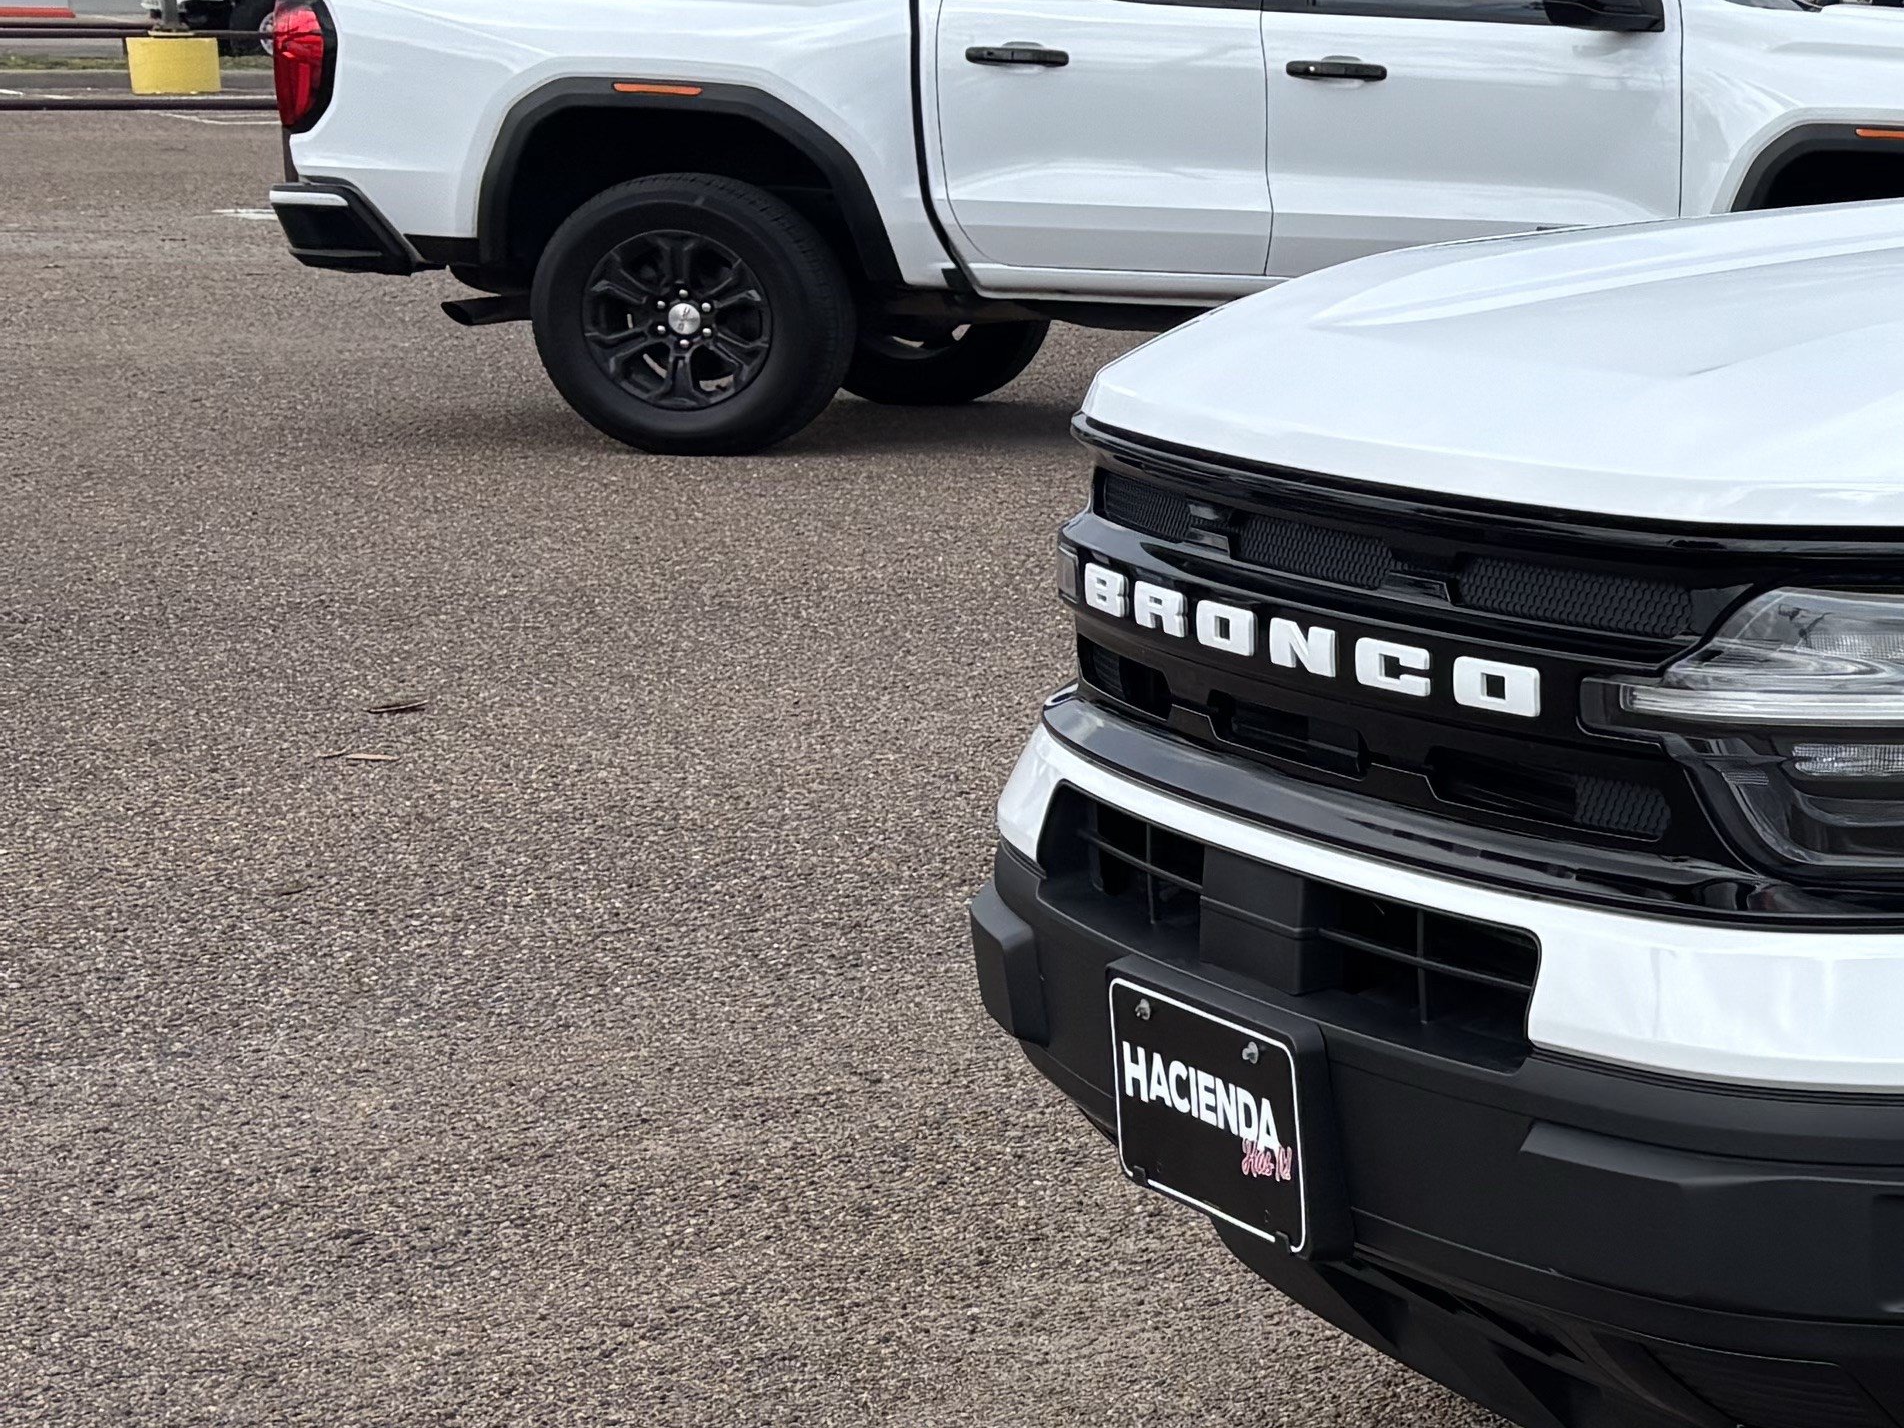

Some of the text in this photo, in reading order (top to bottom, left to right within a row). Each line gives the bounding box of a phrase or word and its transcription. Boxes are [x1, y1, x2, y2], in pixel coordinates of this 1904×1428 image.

[1084, 561, 1542, 719] BRONCO
[1121, 1039, 1283, 1154] HACIENDA
[1241, 1139, 1275, 1179] Has
